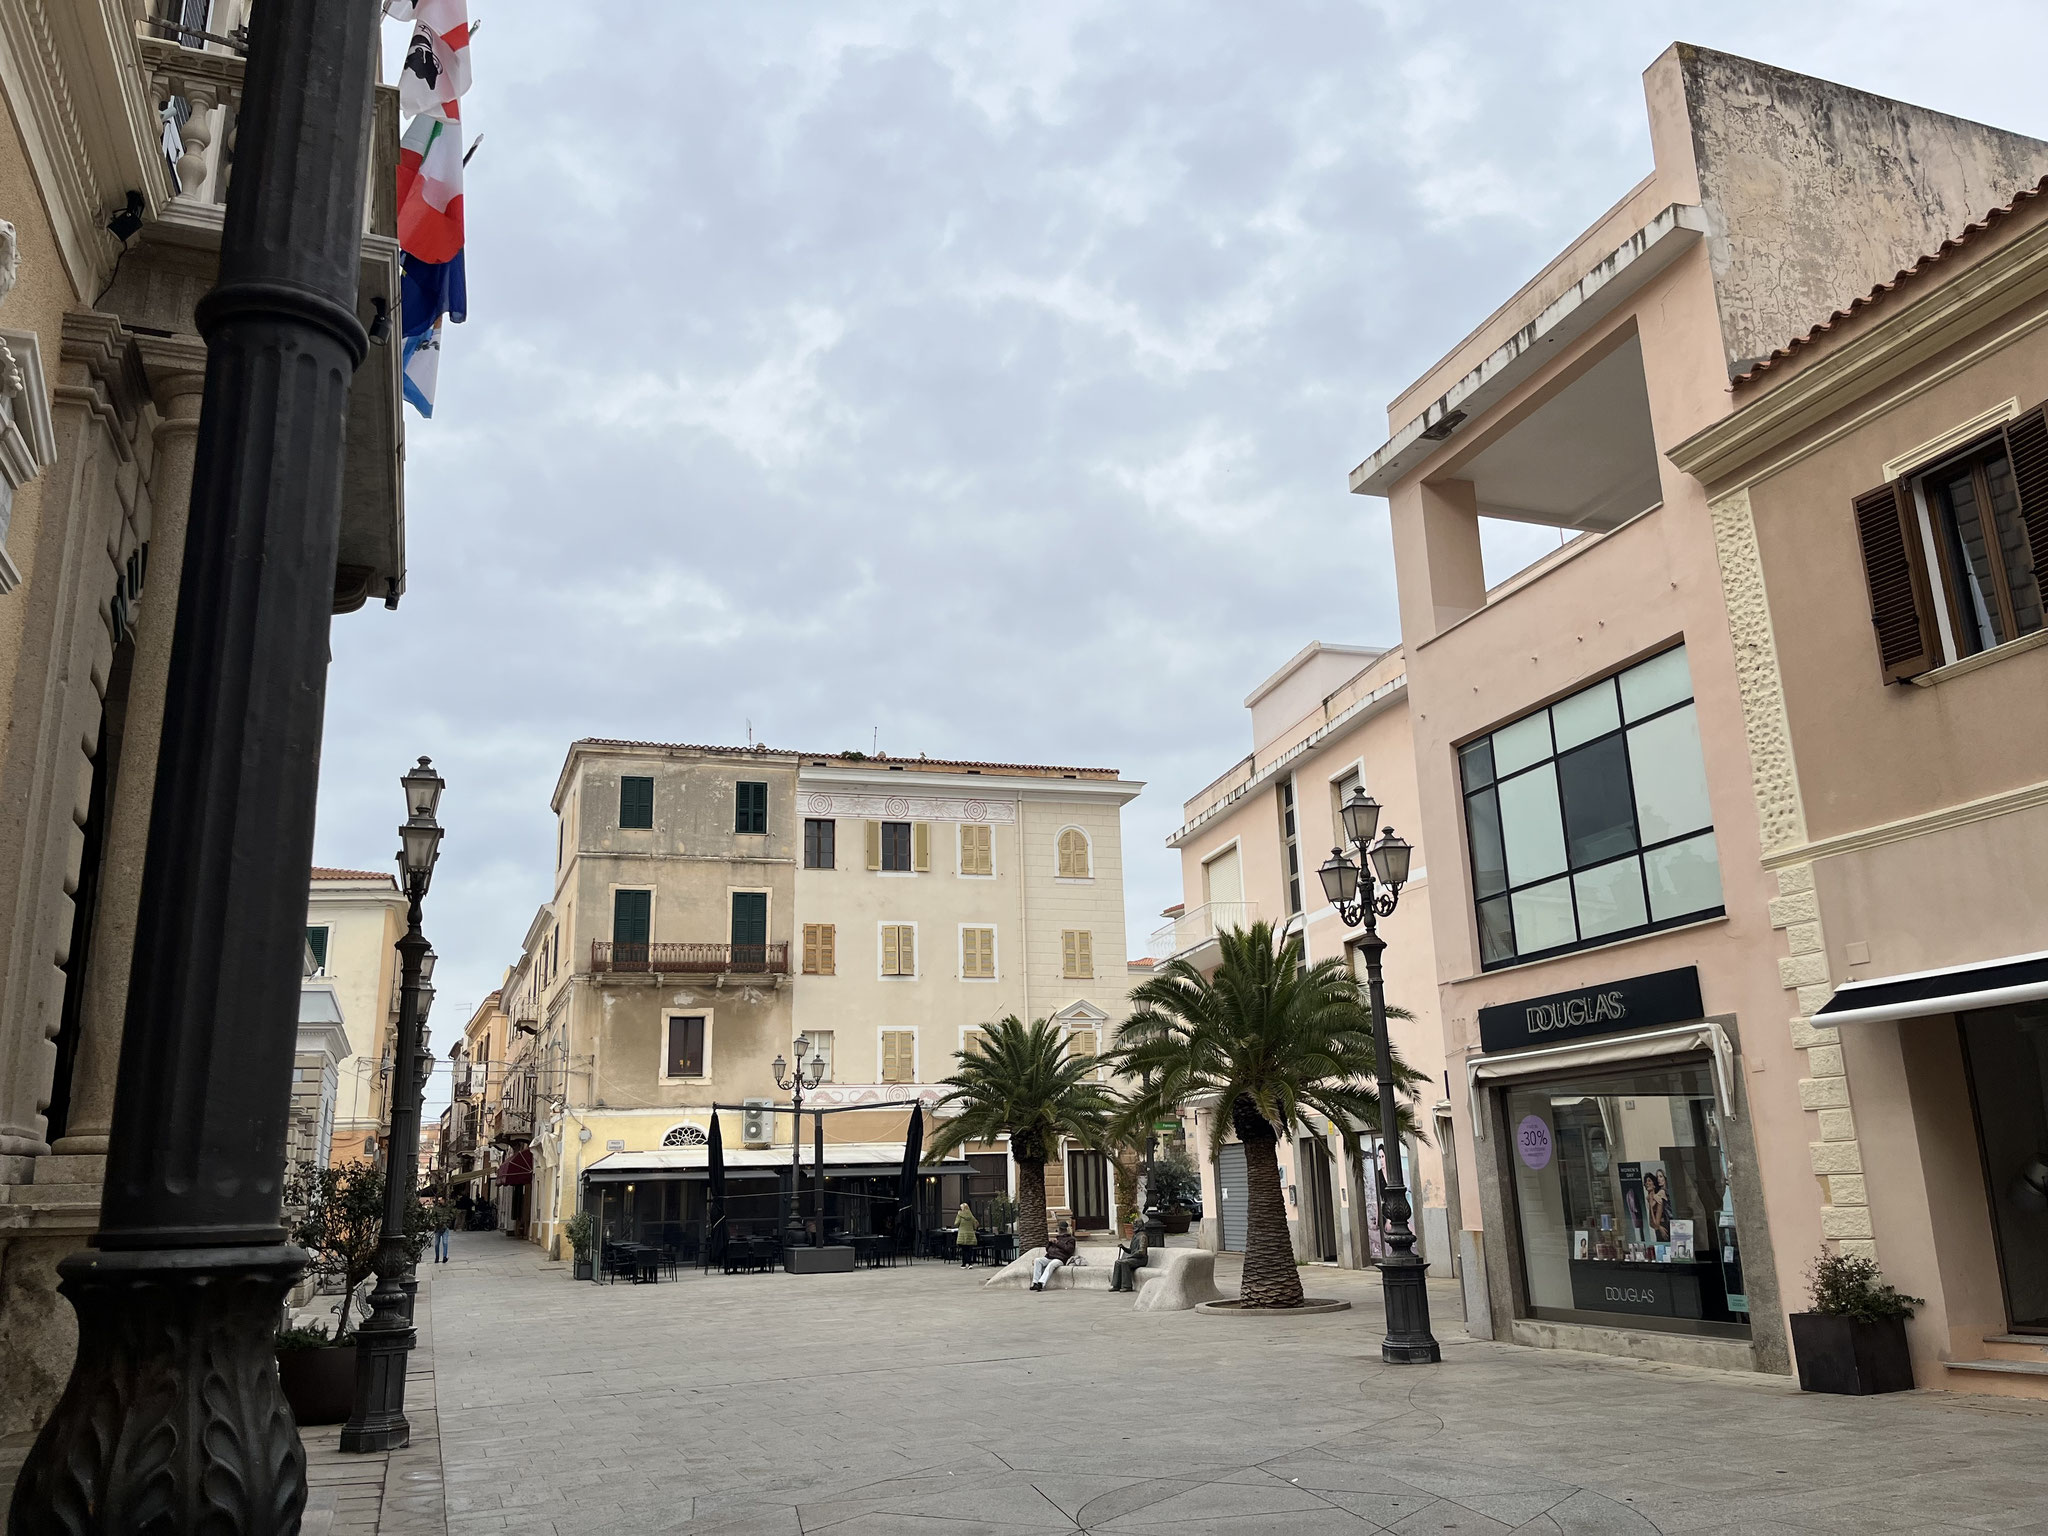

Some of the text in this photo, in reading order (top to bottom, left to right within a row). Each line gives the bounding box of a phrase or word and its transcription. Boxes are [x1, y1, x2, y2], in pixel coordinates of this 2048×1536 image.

[1526, 991, 1626, 1034] DOUGLAS
[1520, 1129, 1548, 1147] -30%
[1605, 1286, 1655, 1304] DOUGLAS
